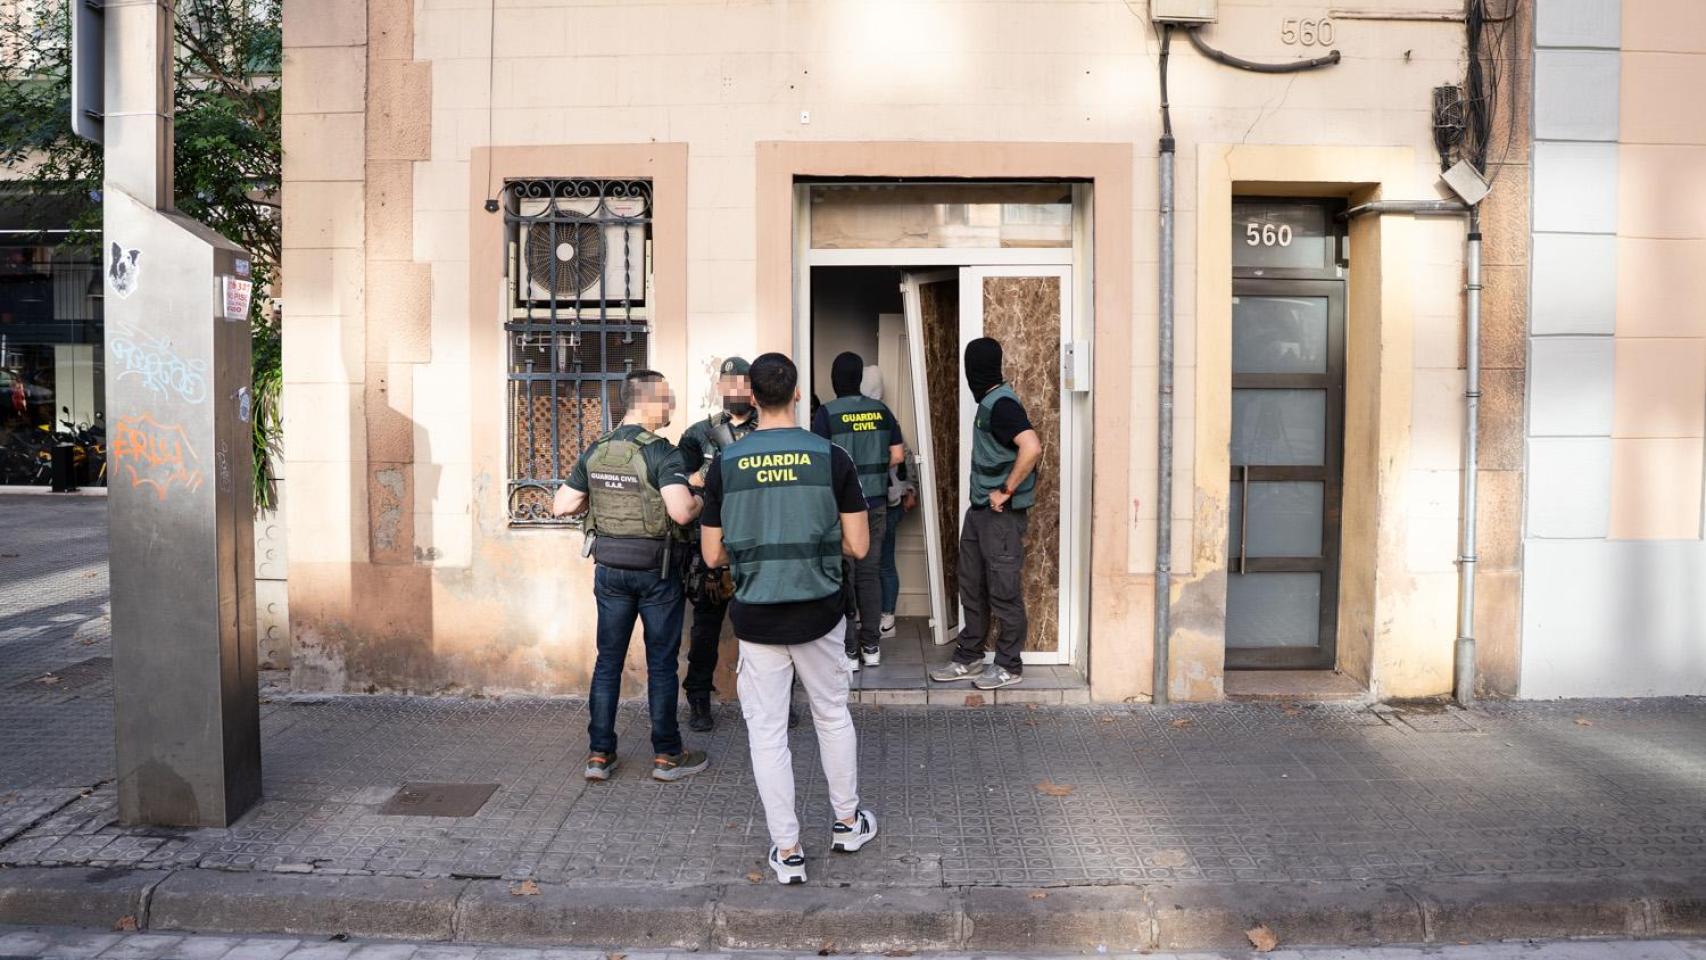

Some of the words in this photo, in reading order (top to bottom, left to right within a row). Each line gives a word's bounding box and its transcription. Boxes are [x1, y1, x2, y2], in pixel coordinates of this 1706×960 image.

[1281, 18, 1335, 47] 560
[1247, 223, 1292, 247] 560
[842, 412, 883, 423] GUARDIA
[852, 421, 877, 431] CIVIL
[738, 453, 811, 470] GUARDIA
[590, 472, 620, 481] GUARDIA
[620, 475, 638, 483] CIVIL
[756, 468, 798, 483] CIVIL
